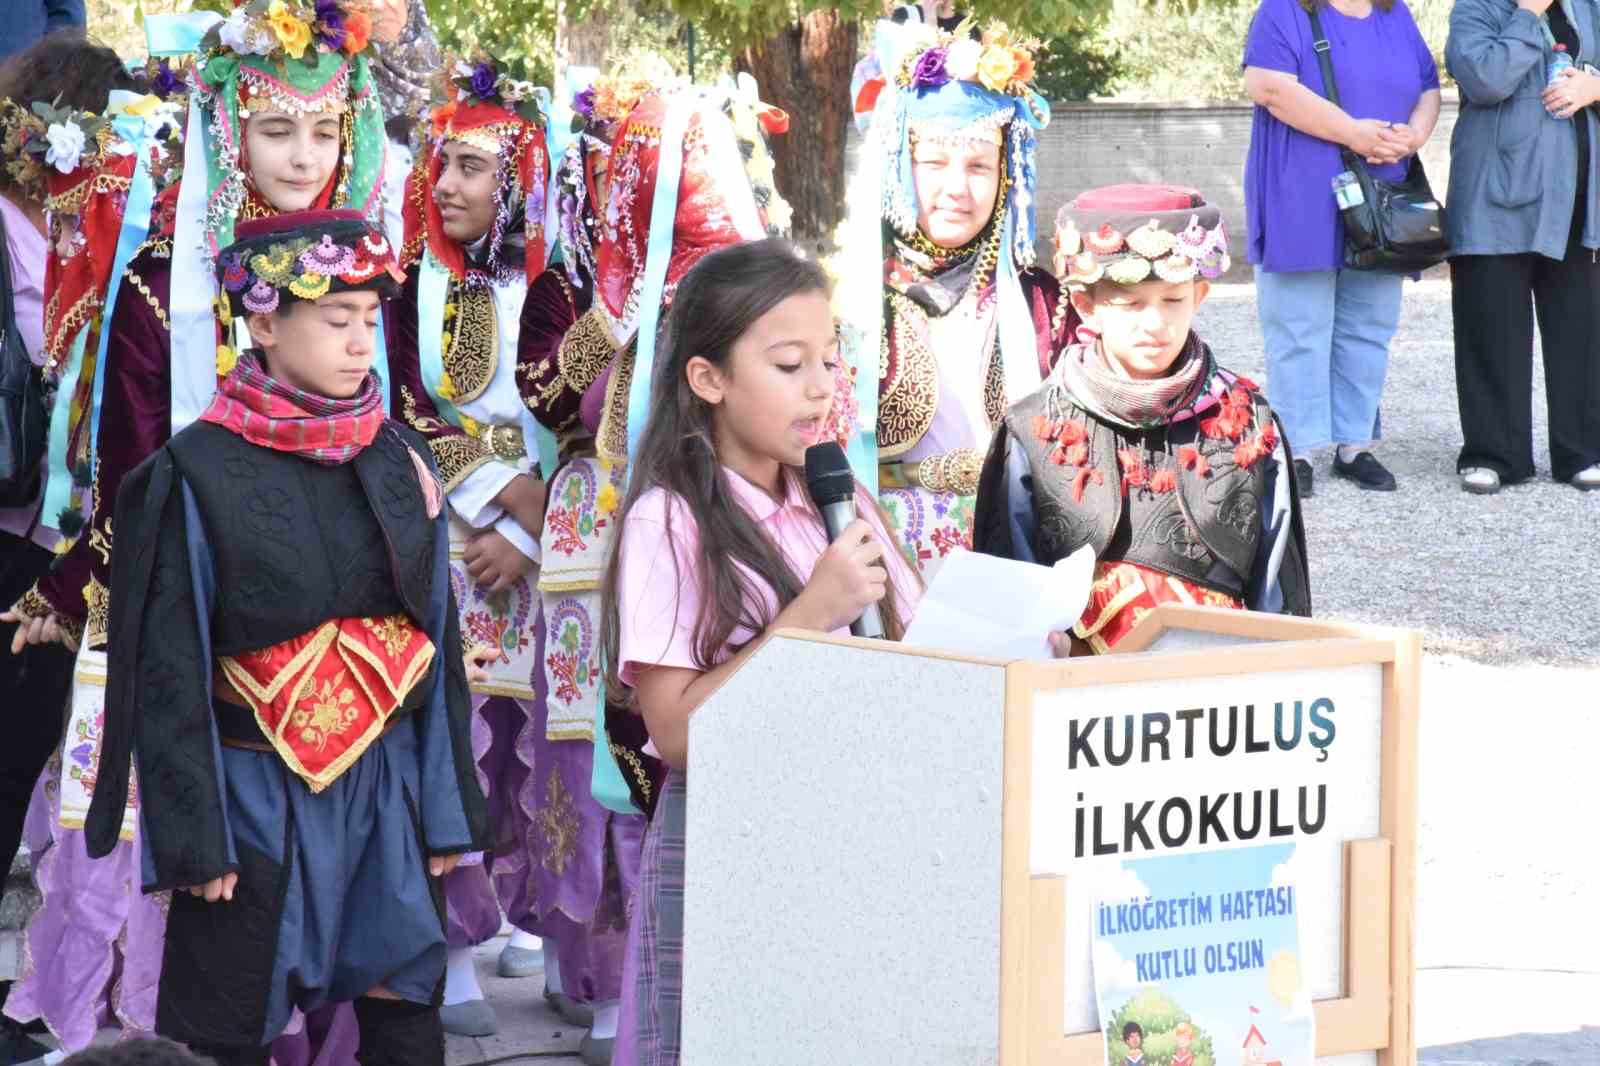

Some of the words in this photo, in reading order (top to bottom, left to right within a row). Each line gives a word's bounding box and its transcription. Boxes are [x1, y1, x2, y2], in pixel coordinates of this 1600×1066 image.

[1068, 697, 1336, 769] KURTULUŞ
[1074, 784, 1327, 858] İLKOKULU
[1099, 891, 1212, 936] İLKÖĞRETİM
[1220, 885, 1293, 923] HAFTASI
[1136, 946, 1197, 982] KUTLU
[1205, 939, 1264, 974] OLSUN
